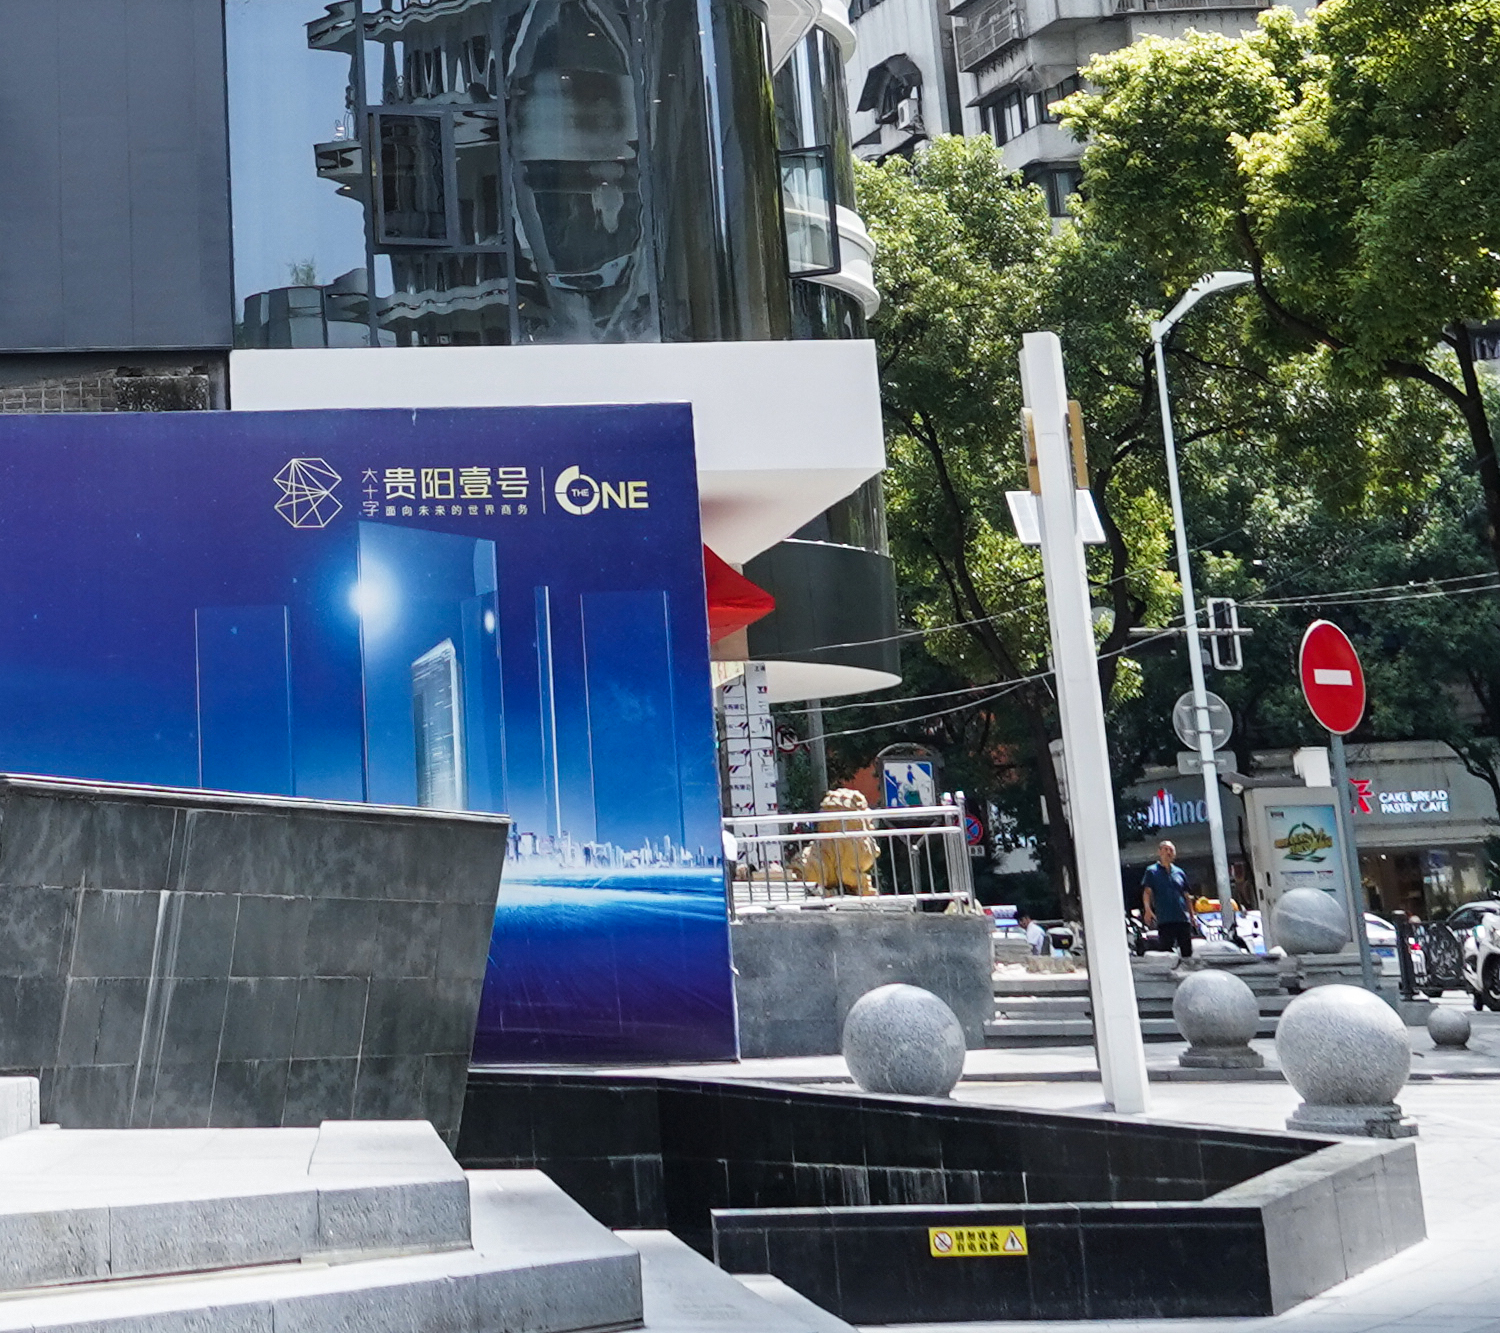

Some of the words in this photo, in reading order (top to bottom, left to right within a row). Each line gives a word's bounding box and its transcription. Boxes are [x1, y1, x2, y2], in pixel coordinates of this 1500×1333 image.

[382, 466, 530, 500] 贵阳壹号
[361, 467, 379, 516] 大十字
[571, 487, 590, 498] THE
[385, 504, 530, 517] 面向未来的世界商务
[1378, 791, 1408, 803] CAKE
[1411, 789, 1449, 802] BREAD
[1420, 800, 1450, 813] CAFE
